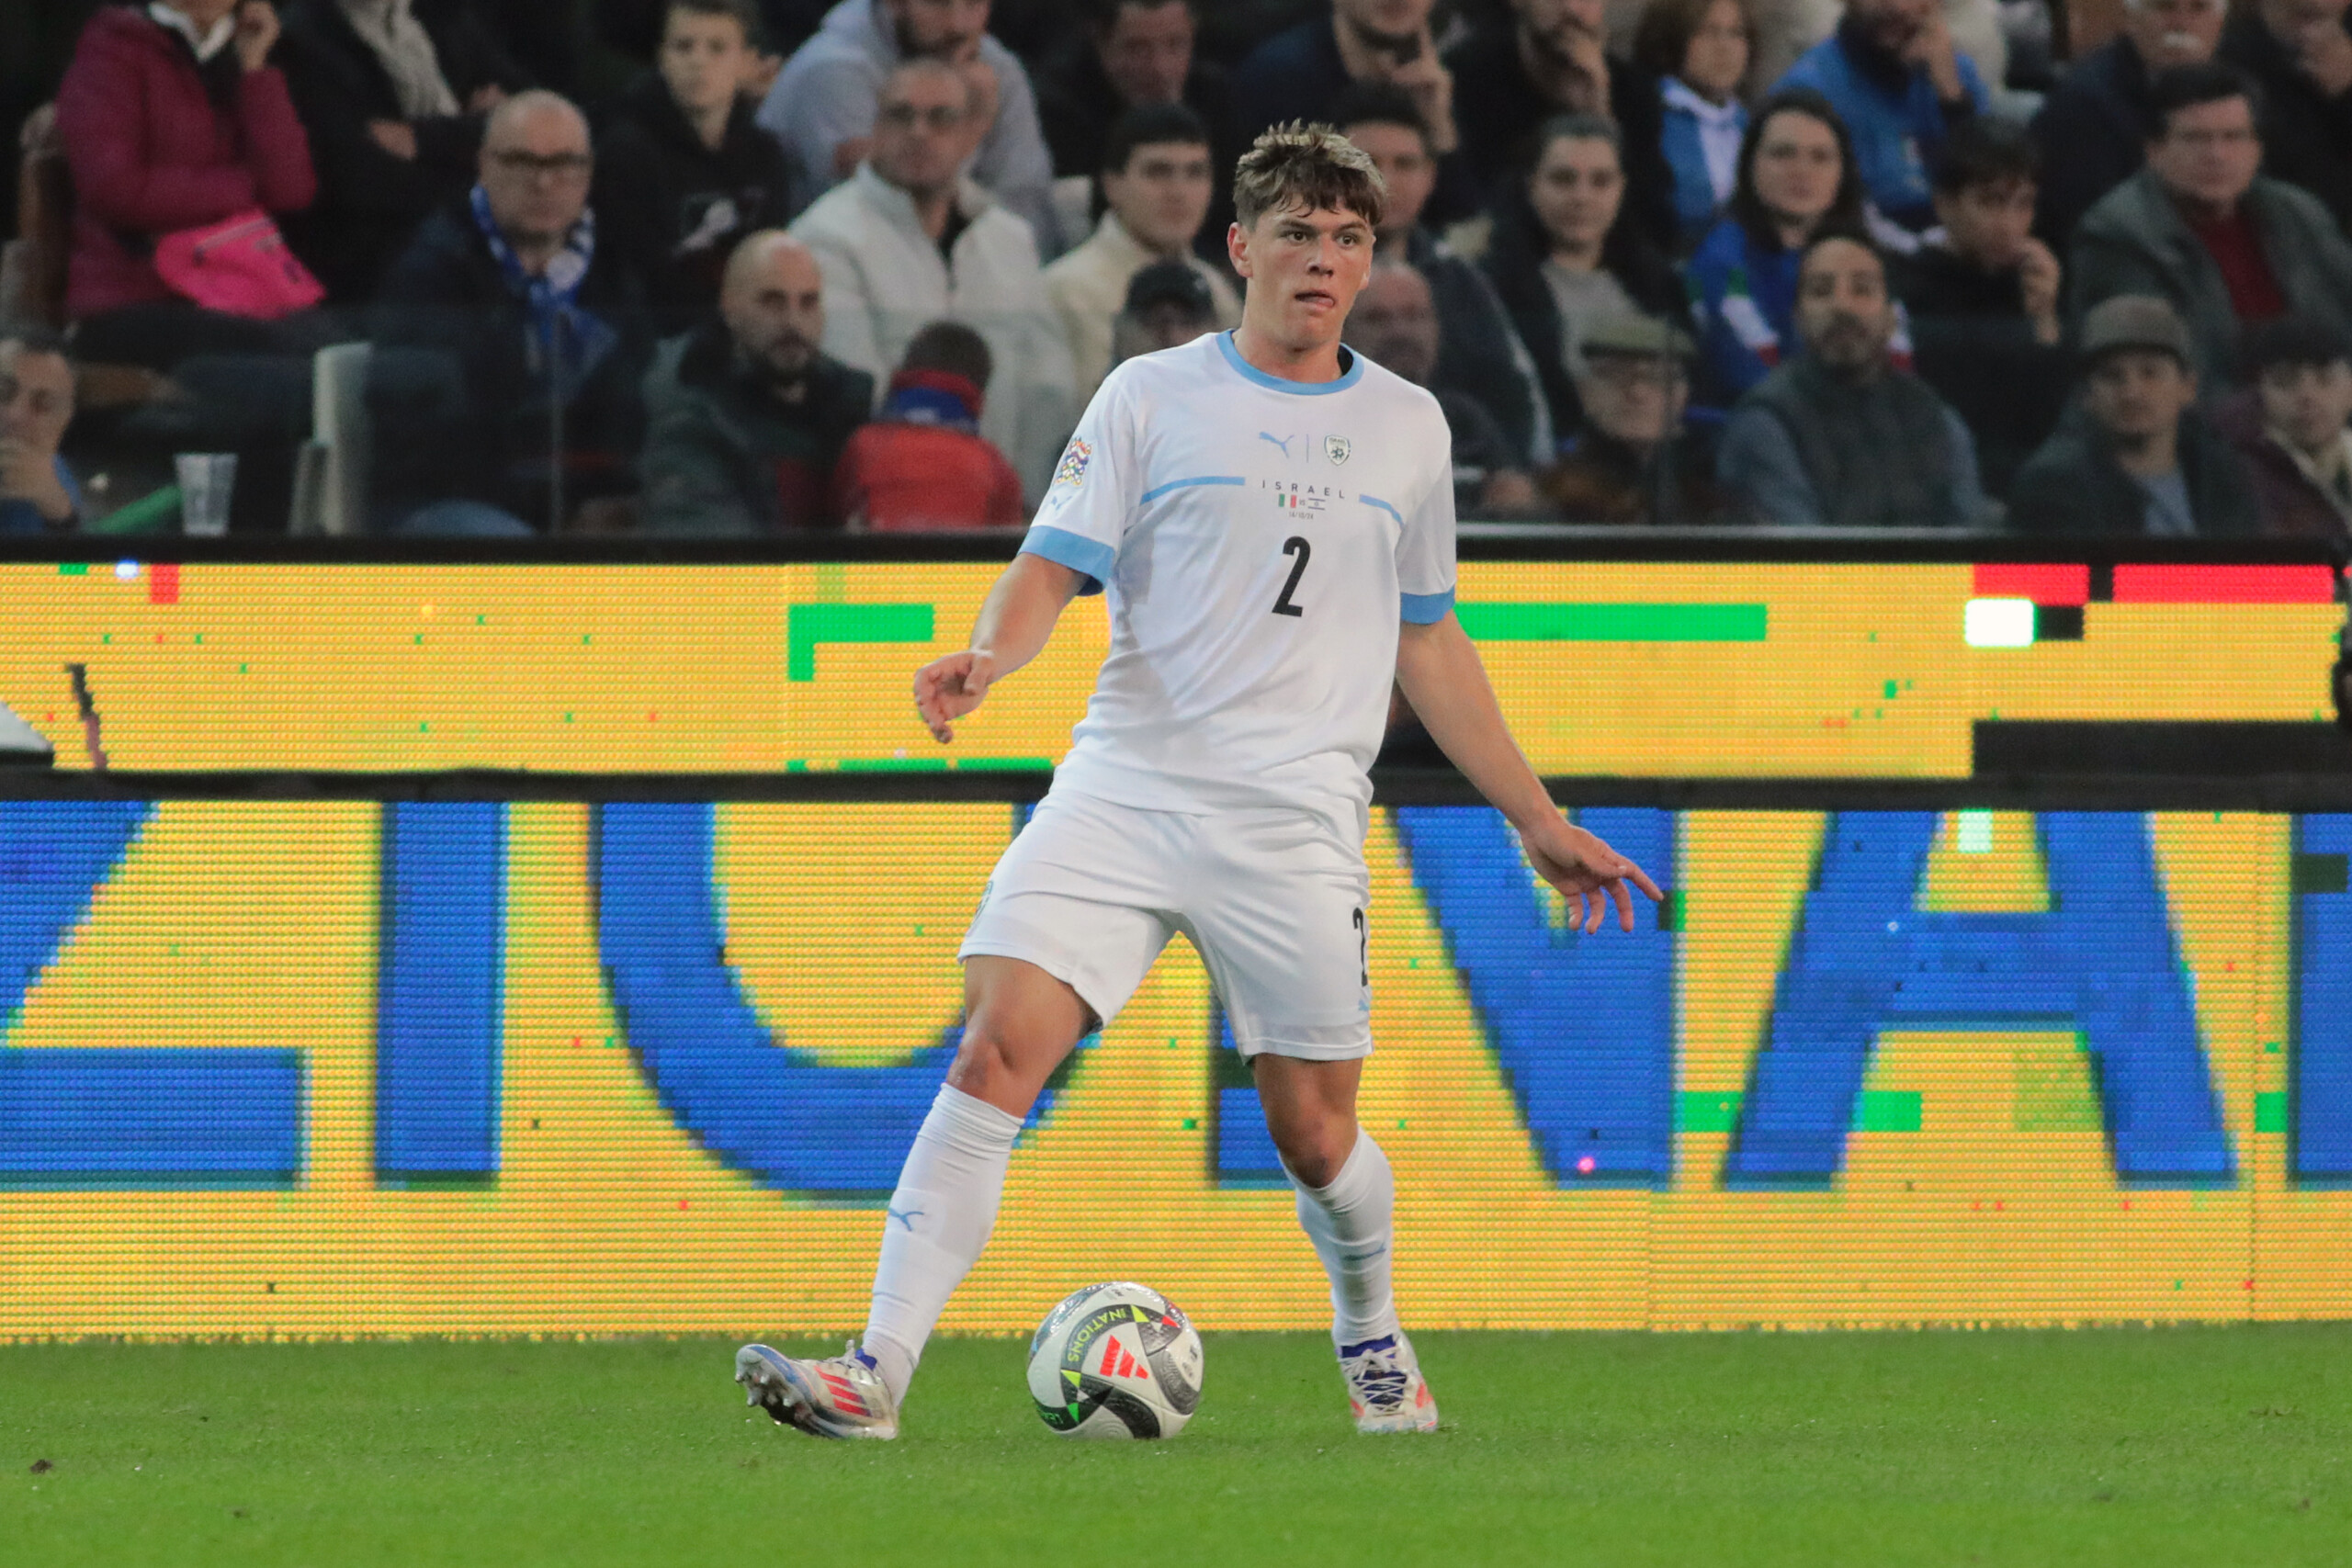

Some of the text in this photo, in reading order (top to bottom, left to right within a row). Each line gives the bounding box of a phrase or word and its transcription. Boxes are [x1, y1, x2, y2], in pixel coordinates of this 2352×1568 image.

[1261, 479, 1345, 499] ISRAEL
[1272, 536, 1311, 617] 2
[1067, 1308, 1123, 1362] NATIONS
